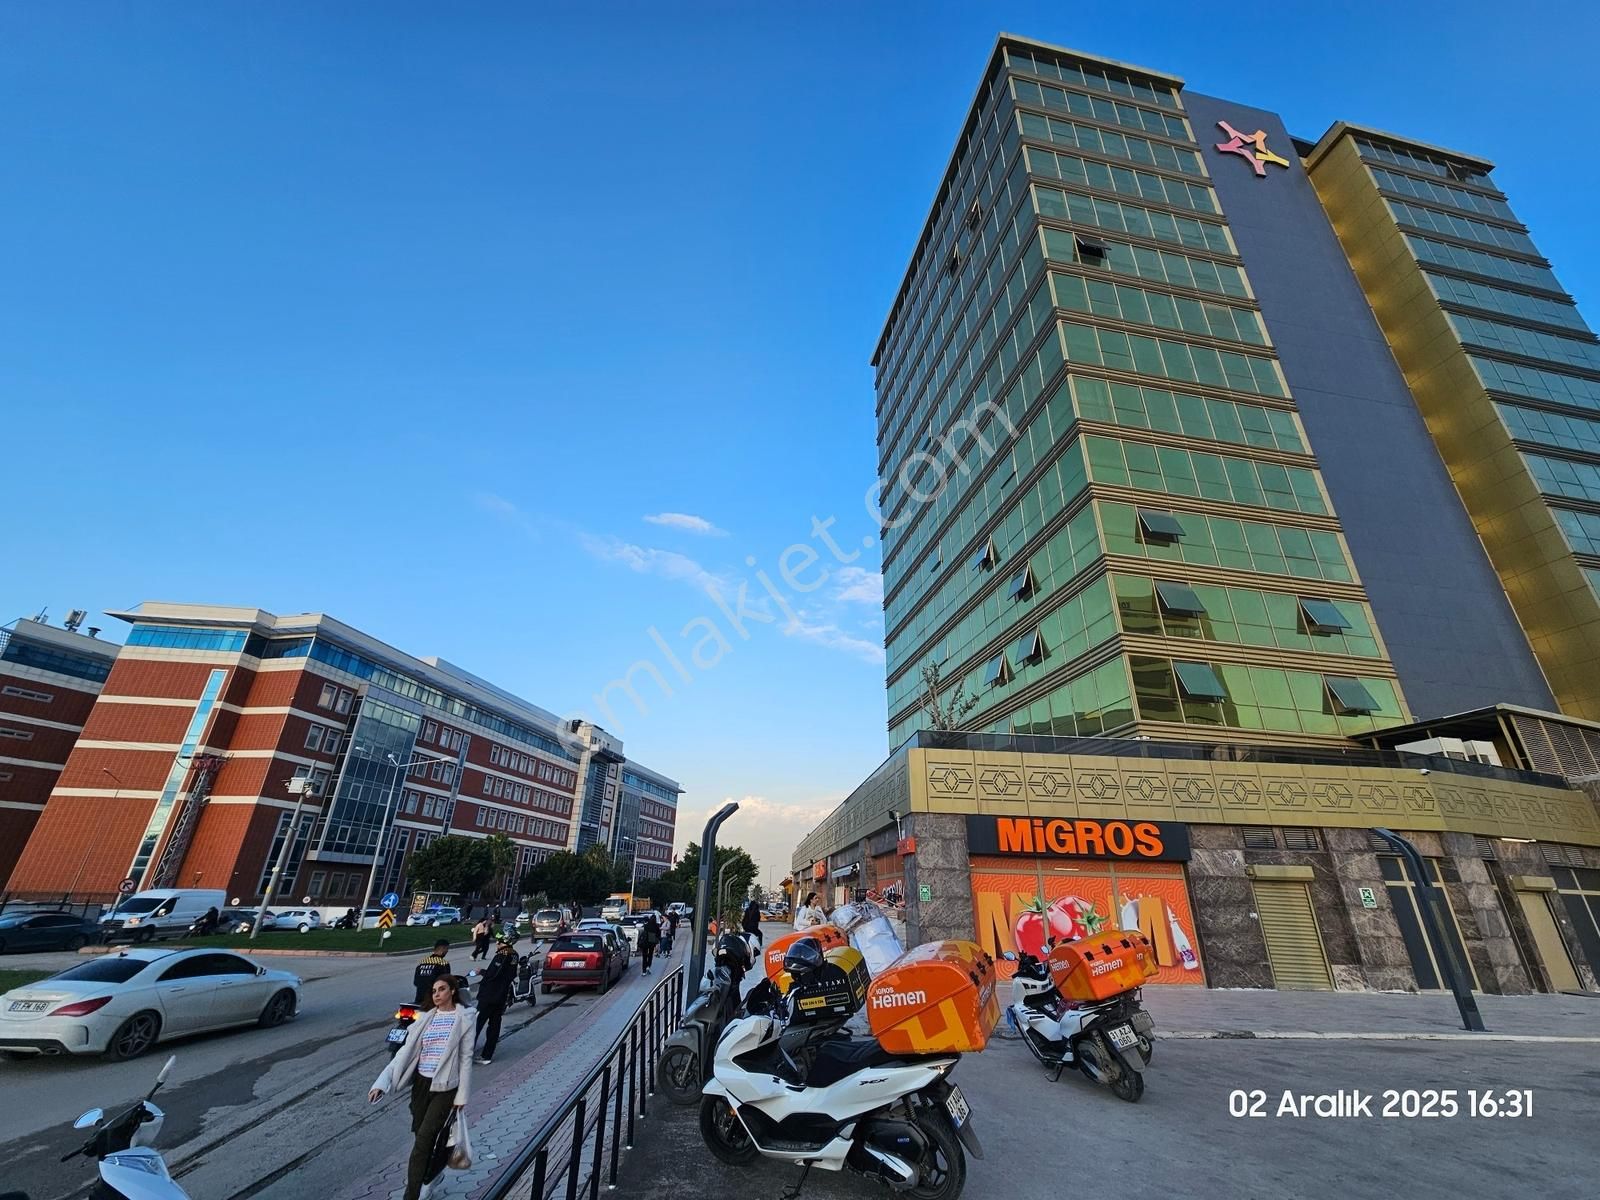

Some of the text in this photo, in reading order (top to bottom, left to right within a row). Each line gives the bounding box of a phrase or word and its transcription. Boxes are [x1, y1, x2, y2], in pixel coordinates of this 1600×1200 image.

[997, 817, 1164, 857] MiGROS
[1092, 958, 1123, 977] Hemen
[872, 990, 927, 1009] Hemen
